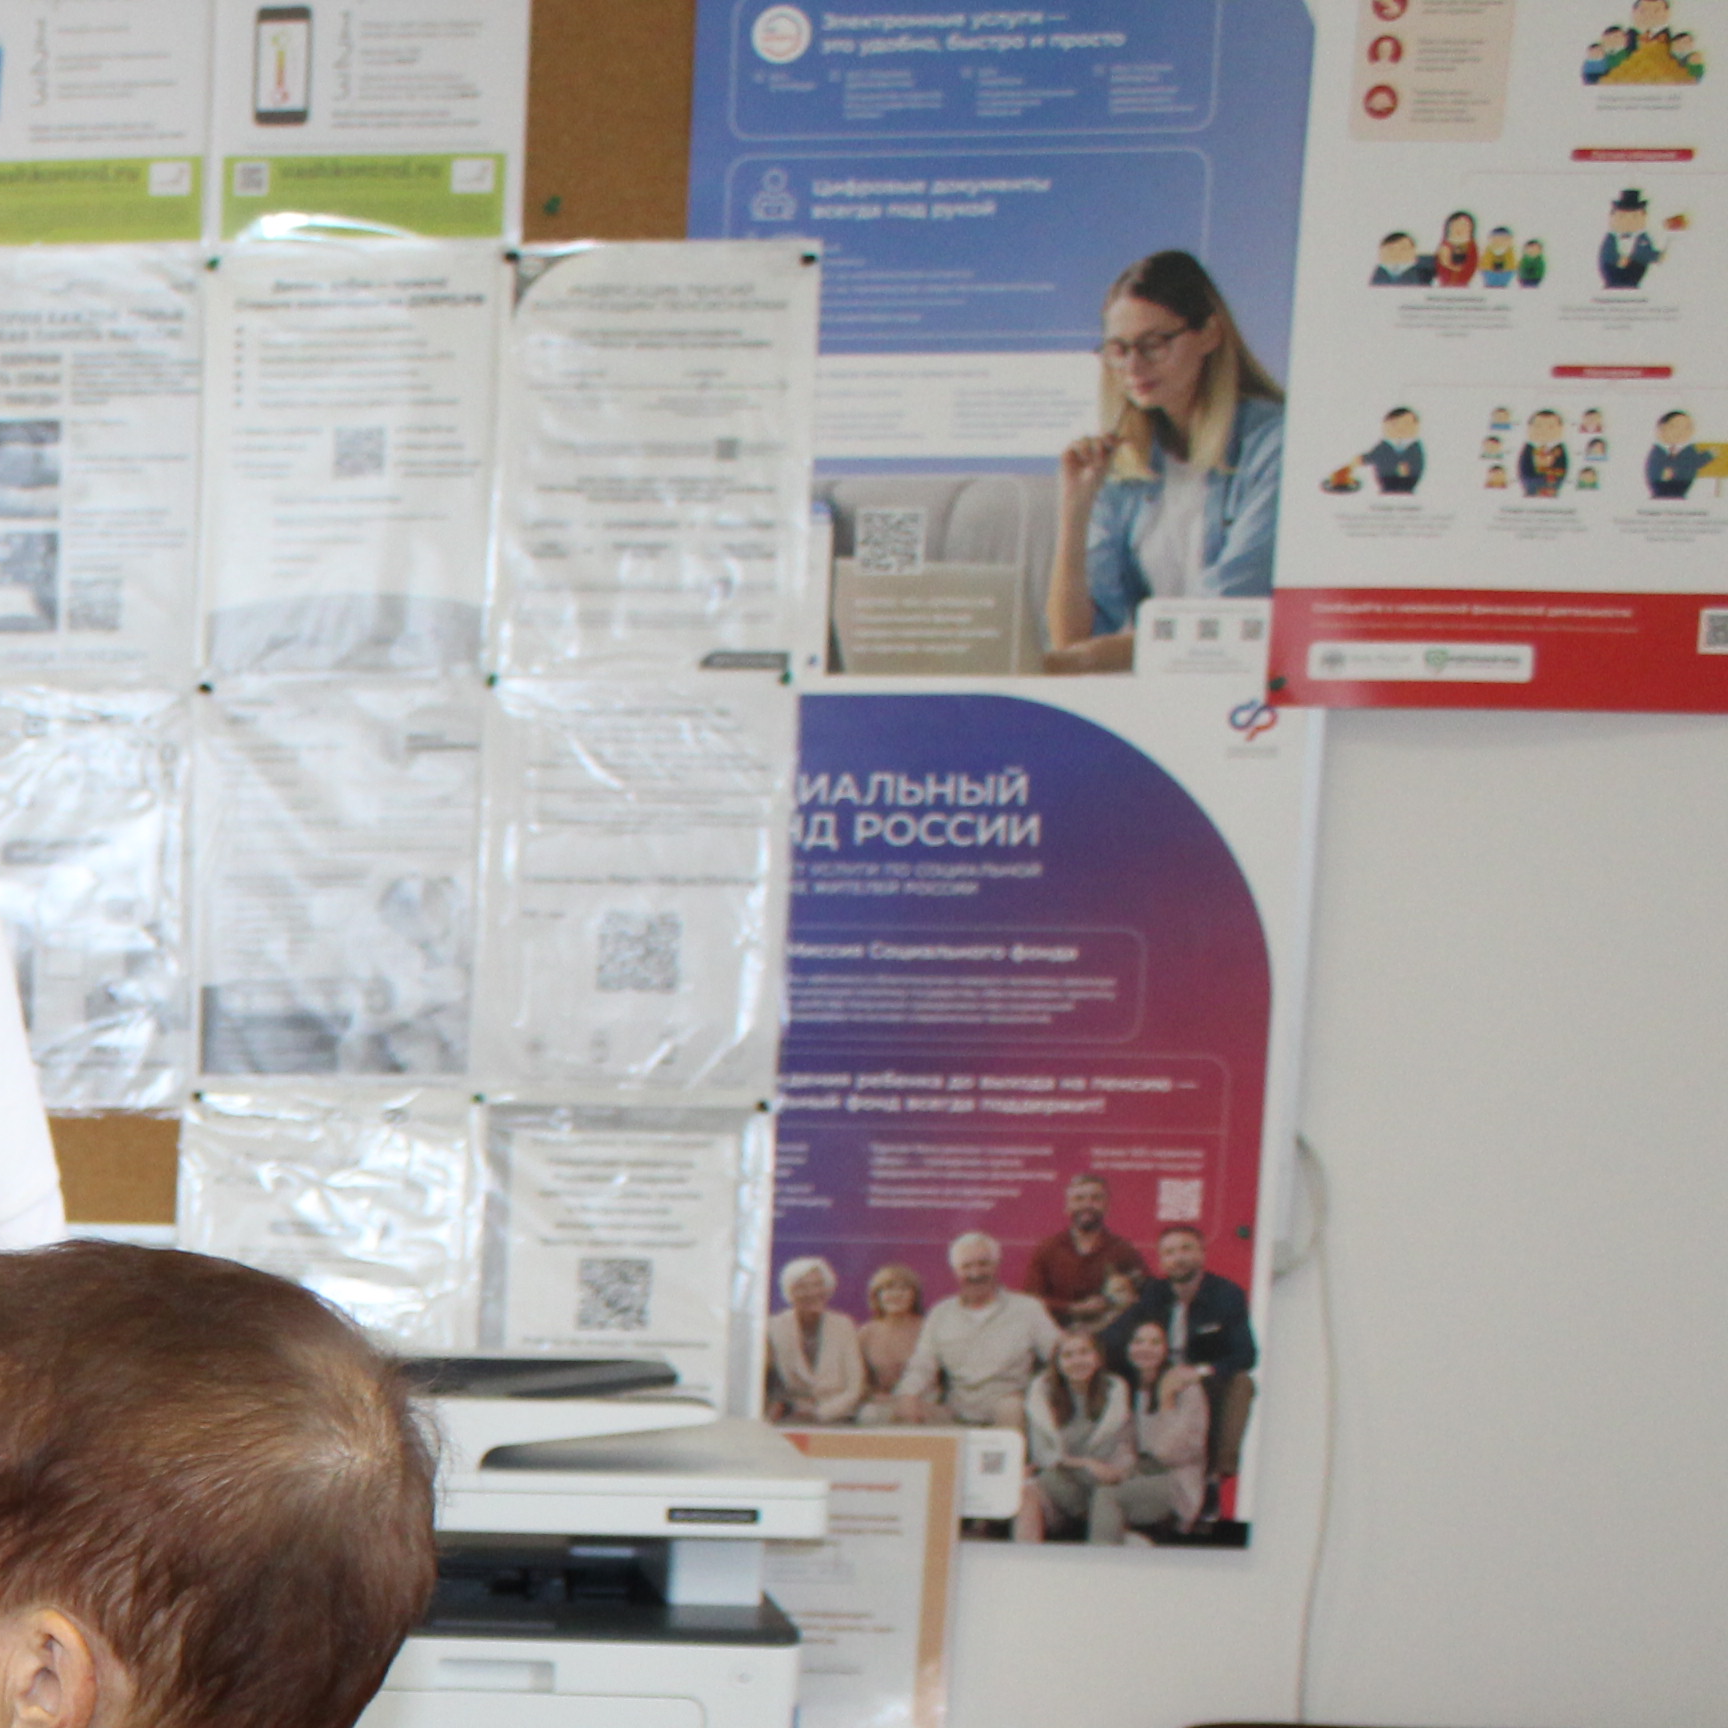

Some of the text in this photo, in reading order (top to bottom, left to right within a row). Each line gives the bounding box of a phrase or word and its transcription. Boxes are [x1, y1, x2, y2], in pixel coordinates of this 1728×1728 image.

[798, 765, 1030, 808] ИАЛЬНЫЙ
[790, 812, 1042, 850] НД РОССИИ
